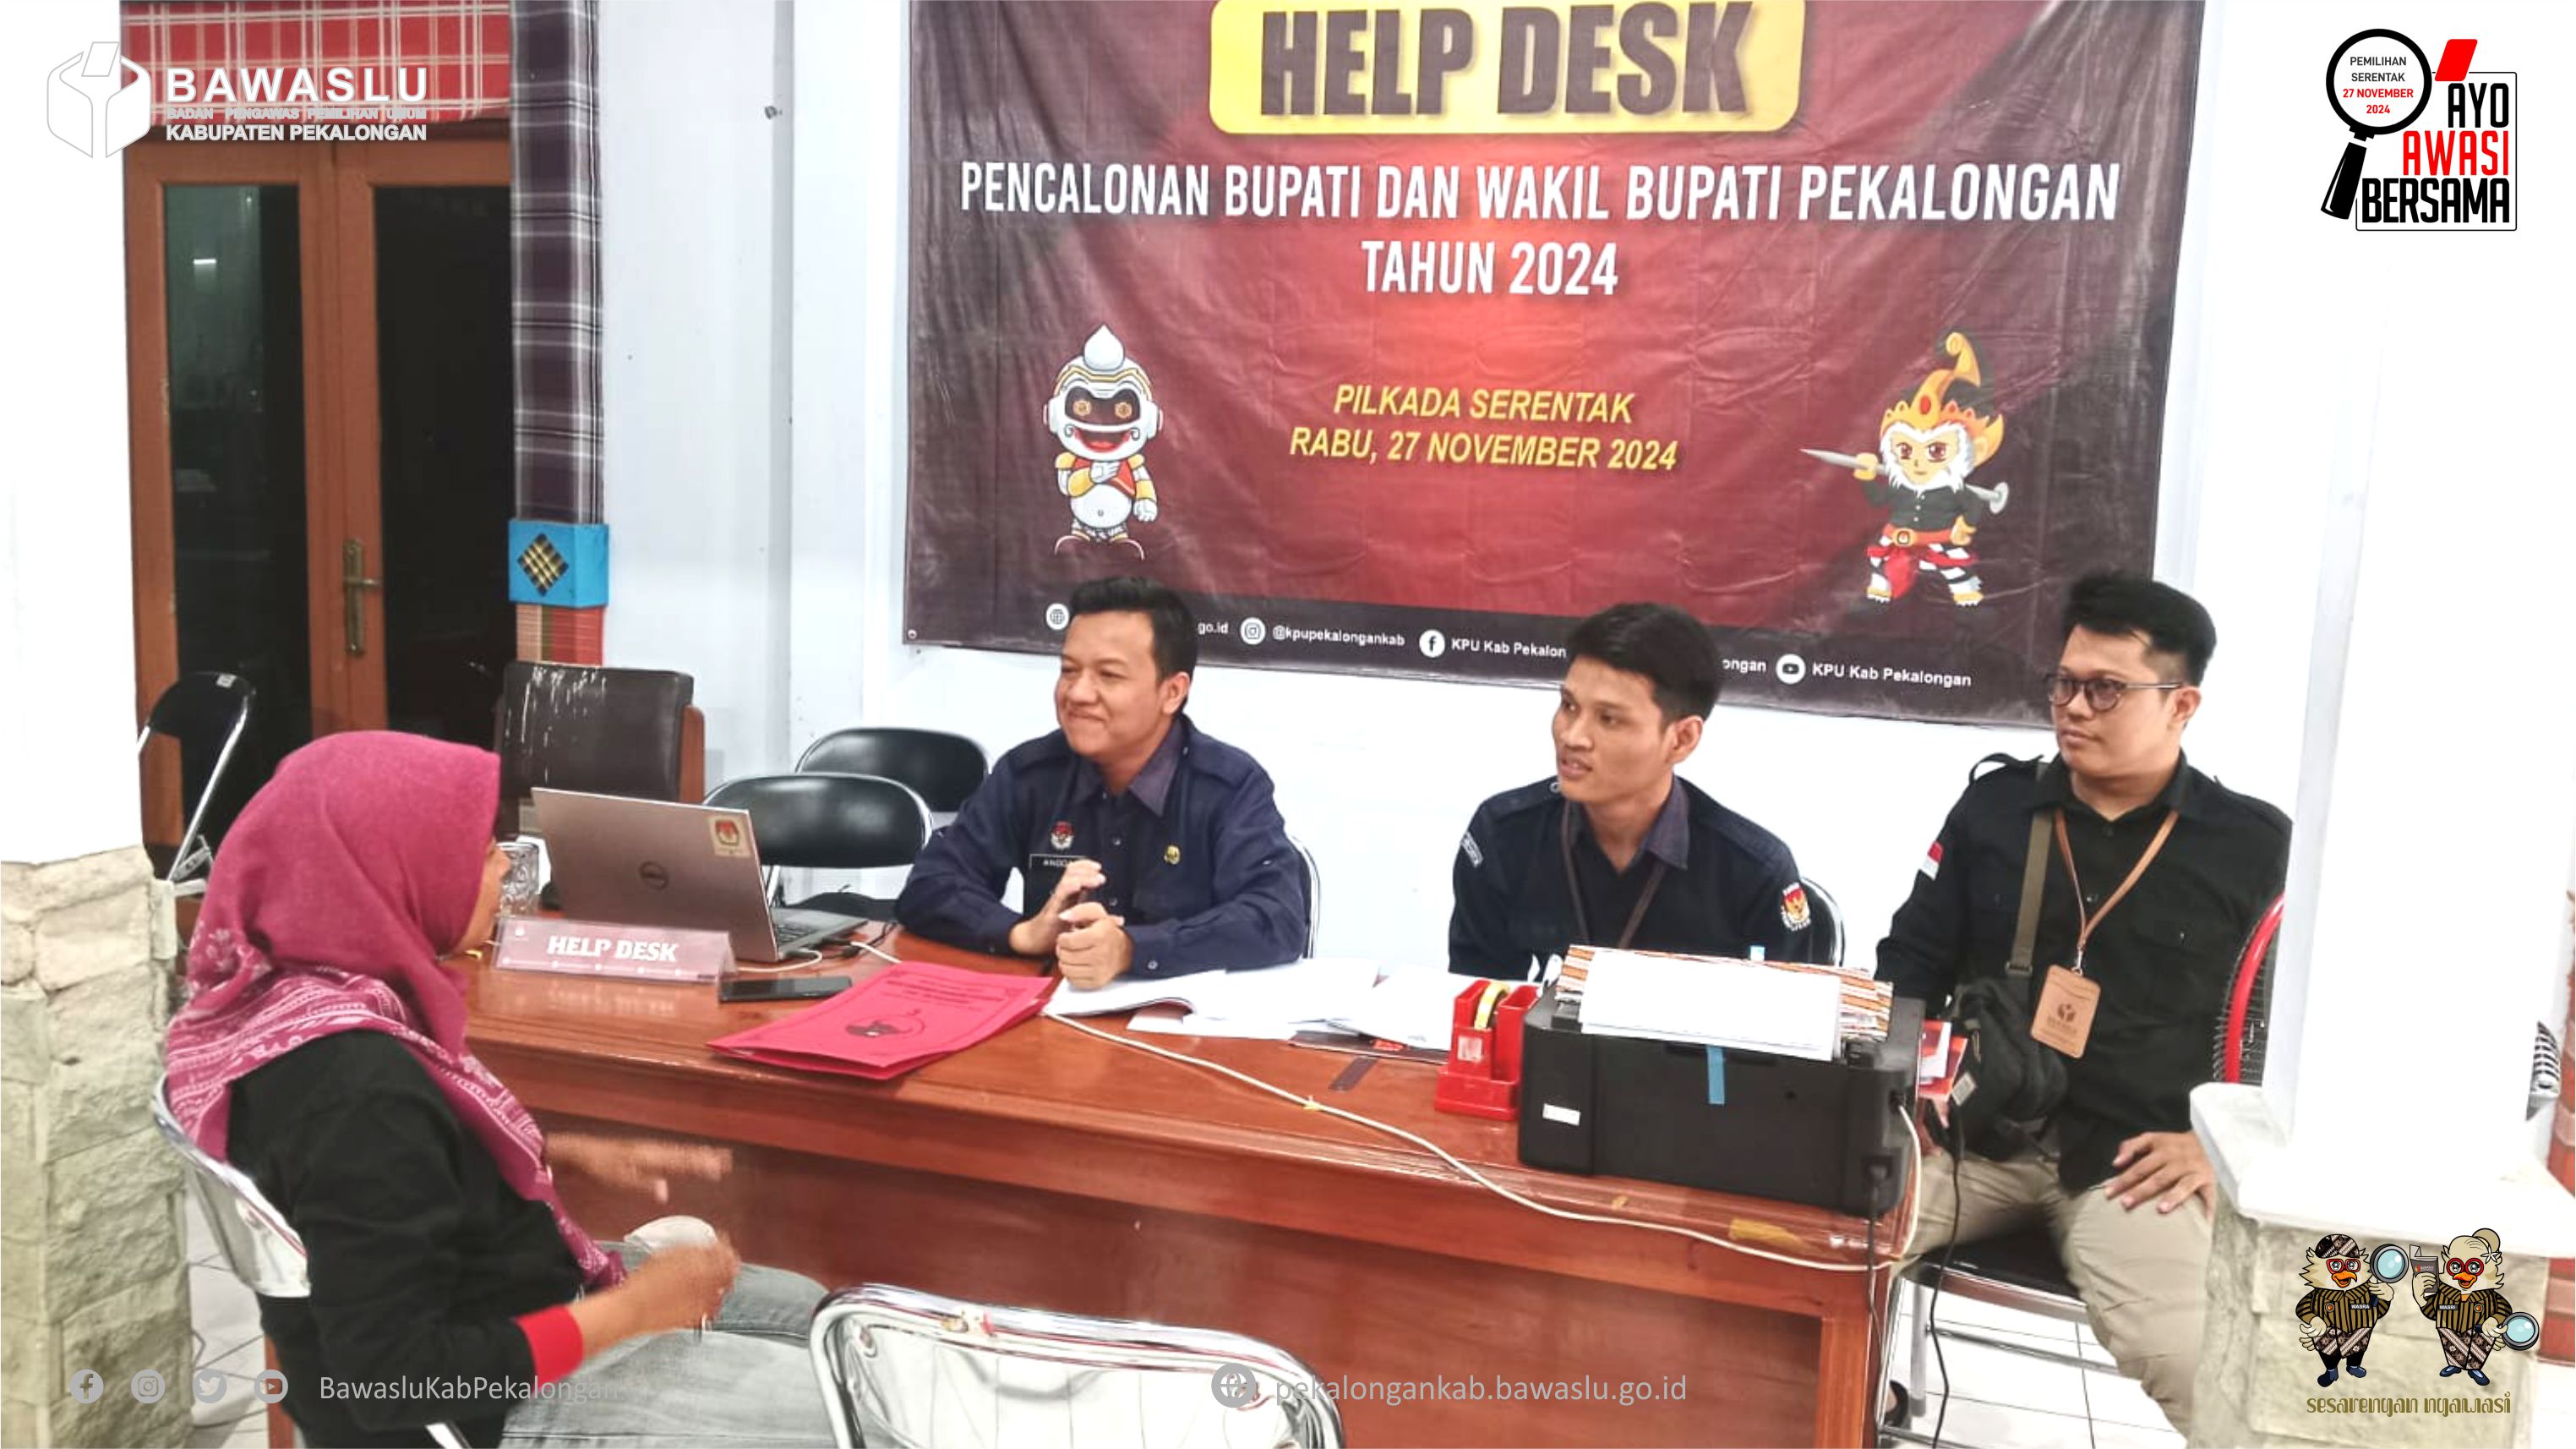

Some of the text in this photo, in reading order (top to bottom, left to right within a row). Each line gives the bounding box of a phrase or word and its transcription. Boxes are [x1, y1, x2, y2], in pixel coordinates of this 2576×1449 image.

[1261, 1, 1752, 116] HELP DESK
[960, 161, 2120, 221] PENCALONAN BUPATI DAN WAKIL BUPATI PEKALONGAN
[1362, 240, 1618, 295] TAHUN 2024
[1334, 383, 1635, 424] PILKADA SERENTAK
[1289, 426, 1678, 471] RABU, 27 NOVEMBER 2024
[1198, 621, 1229, 636] go.id
[1272, 625, 1405, 648] @kpupekalongankab
[1451, 637, 1567, 659] KPU Kab Pekalon
[1812, 662, 1973, 688] KPU Kab Pekalongan
[546, 935, 679, 962] HELP DESK
